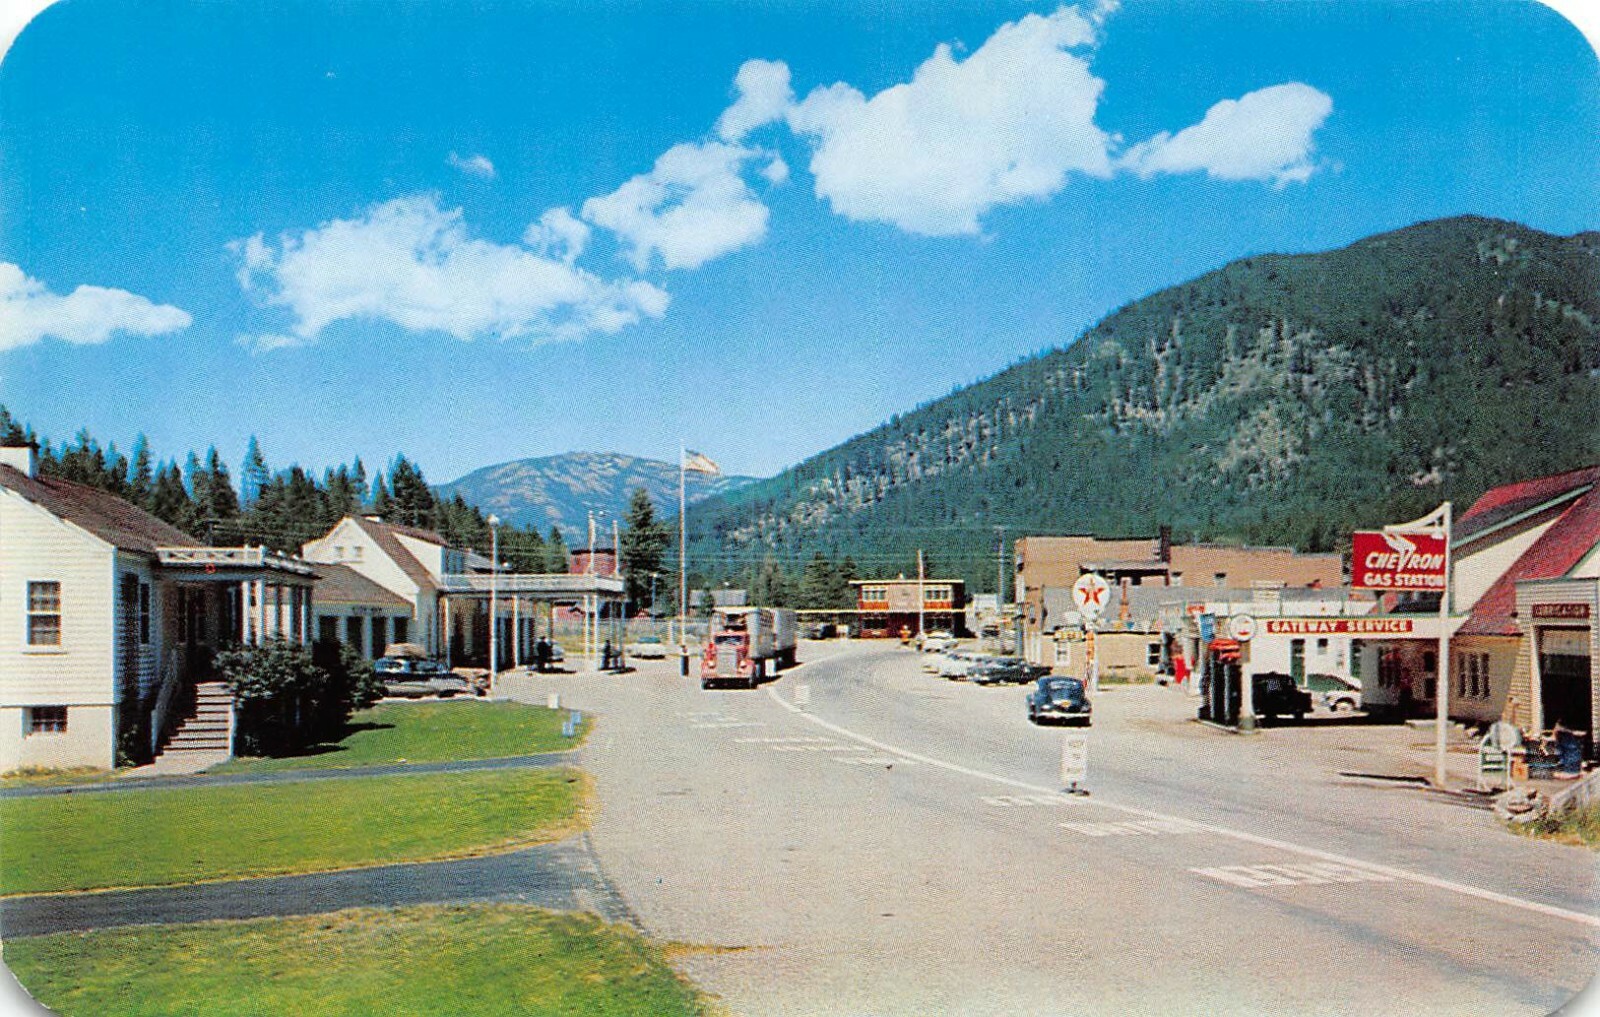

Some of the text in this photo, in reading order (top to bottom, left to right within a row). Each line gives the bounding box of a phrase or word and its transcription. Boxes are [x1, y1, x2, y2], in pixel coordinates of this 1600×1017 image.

[1365, 551, 1444, 572] CHEVRON
[1363, 572, 1444, 587] GAS STATION
[1271, 619, 1406, 633] GATEWAY SERVICE
